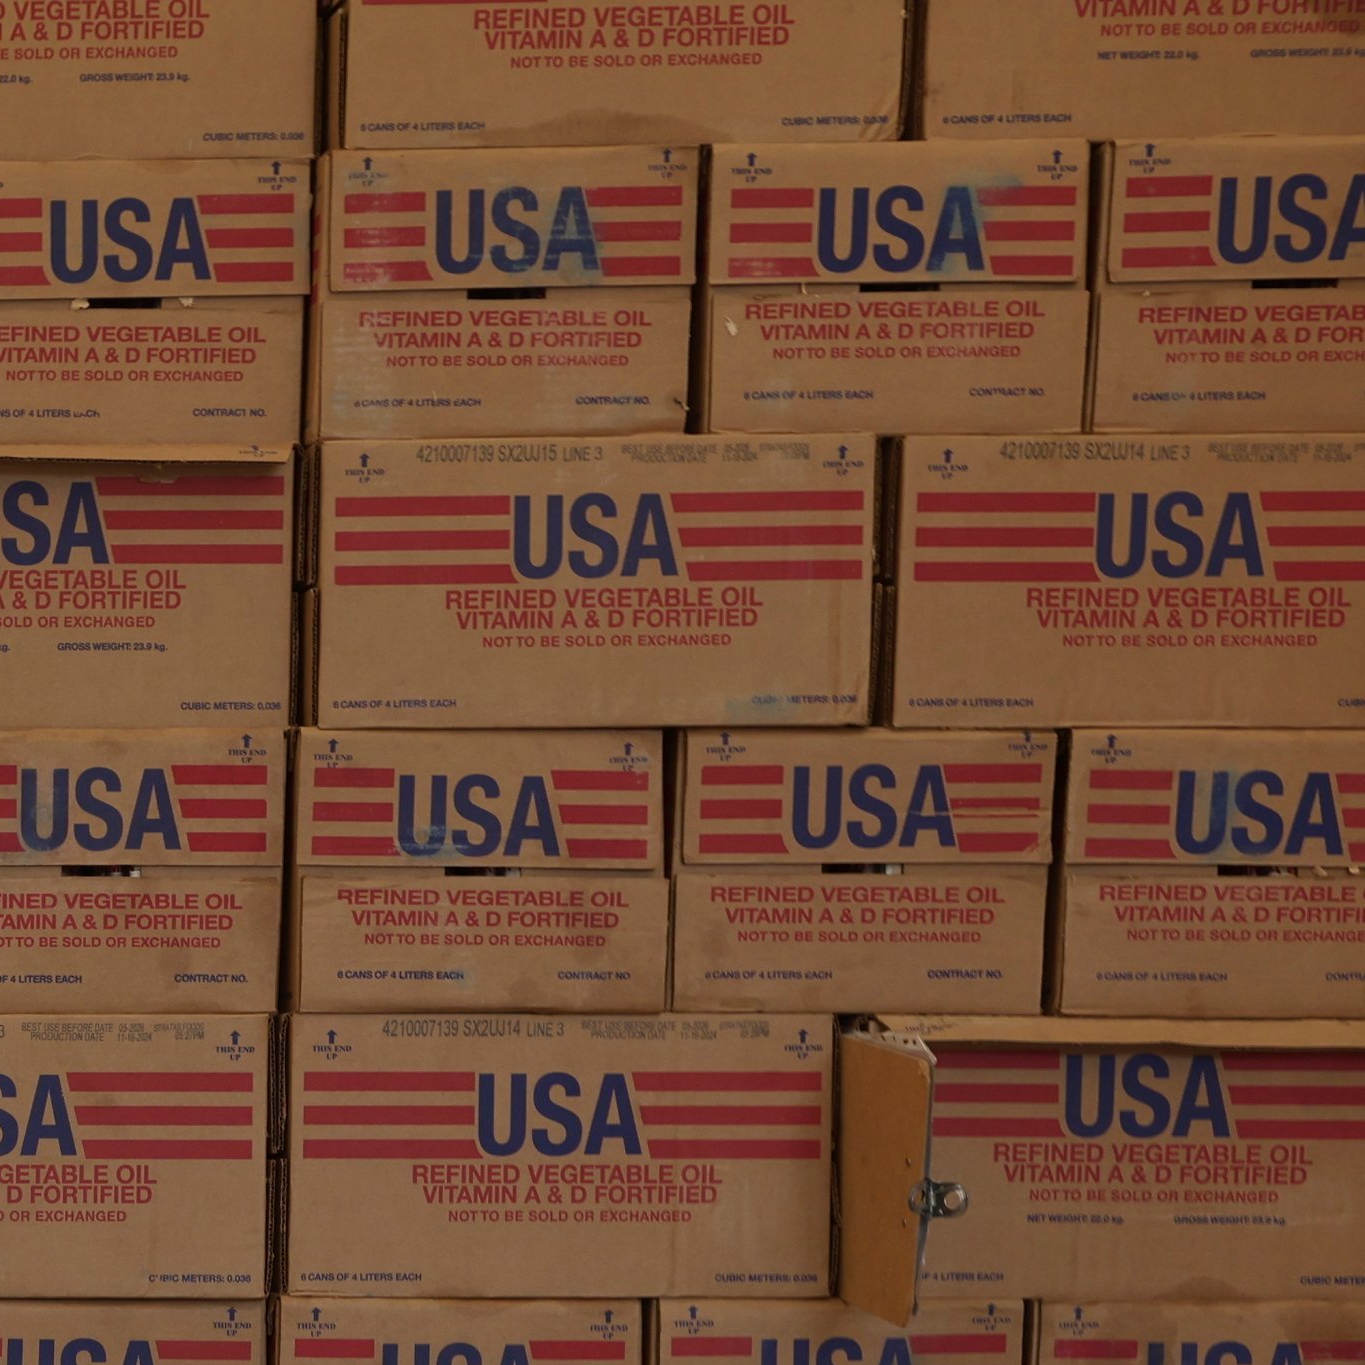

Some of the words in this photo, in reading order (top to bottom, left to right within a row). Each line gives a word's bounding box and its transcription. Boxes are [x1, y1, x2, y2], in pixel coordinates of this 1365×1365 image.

[819, 187, 984, 272] USA
[1097, 493, 1262, 577] USA
[793, 765, 955, 848] USA
[64, 894, 199, 910] VEGETABLE
[205, 894, 243, 911] OIL
[10, 975, 17, 984] 4
[18, 975, 53, 984] LITERS
[55, 975, 83, 984] EACH
[174, 974, 229, 983] CONTRACT
[231, 974, 249, 984] NO.
[1066, 1055, 1229, 1137] USA
